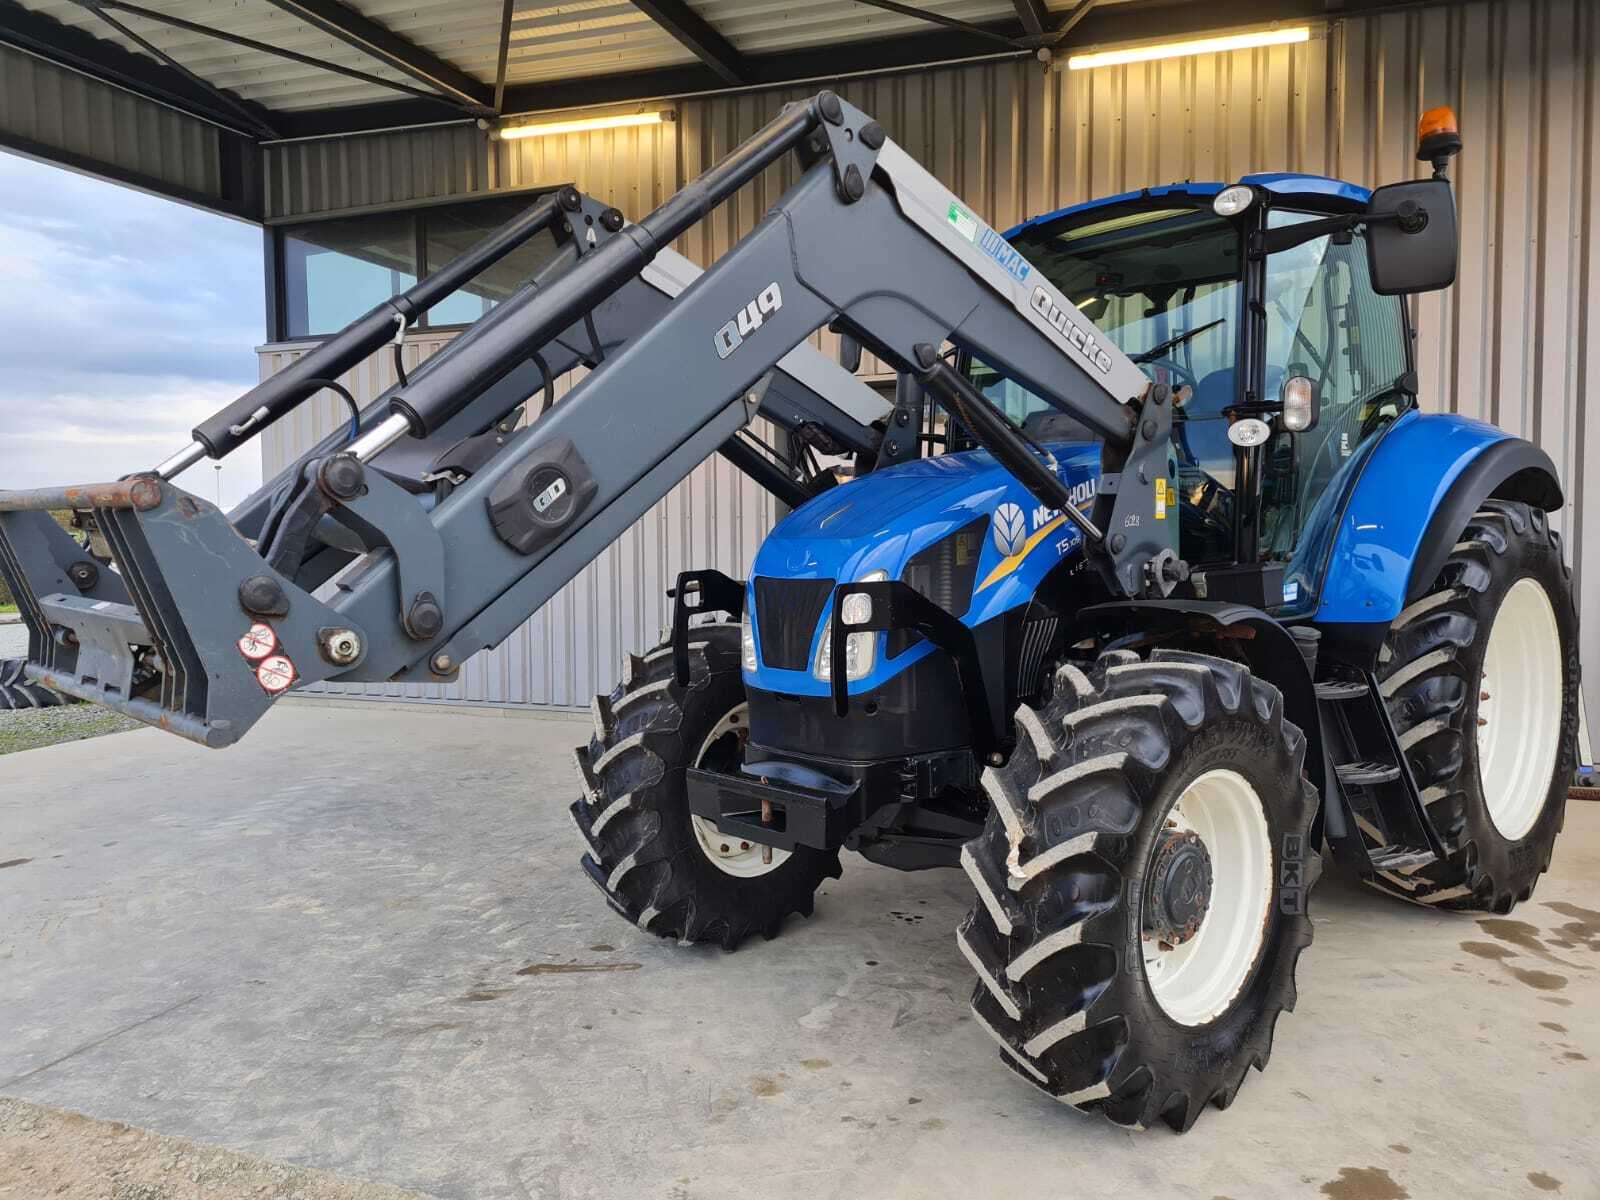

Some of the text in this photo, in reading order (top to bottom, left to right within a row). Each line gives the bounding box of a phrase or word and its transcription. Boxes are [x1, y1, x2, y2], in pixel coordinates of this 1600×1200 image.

[714, 281, 783, 360] Q49
[1030, 286, 1112, 374] Quicke
[1032, 504, 1062, 530] NE
[1279, 832, 1304, 916] BKT
